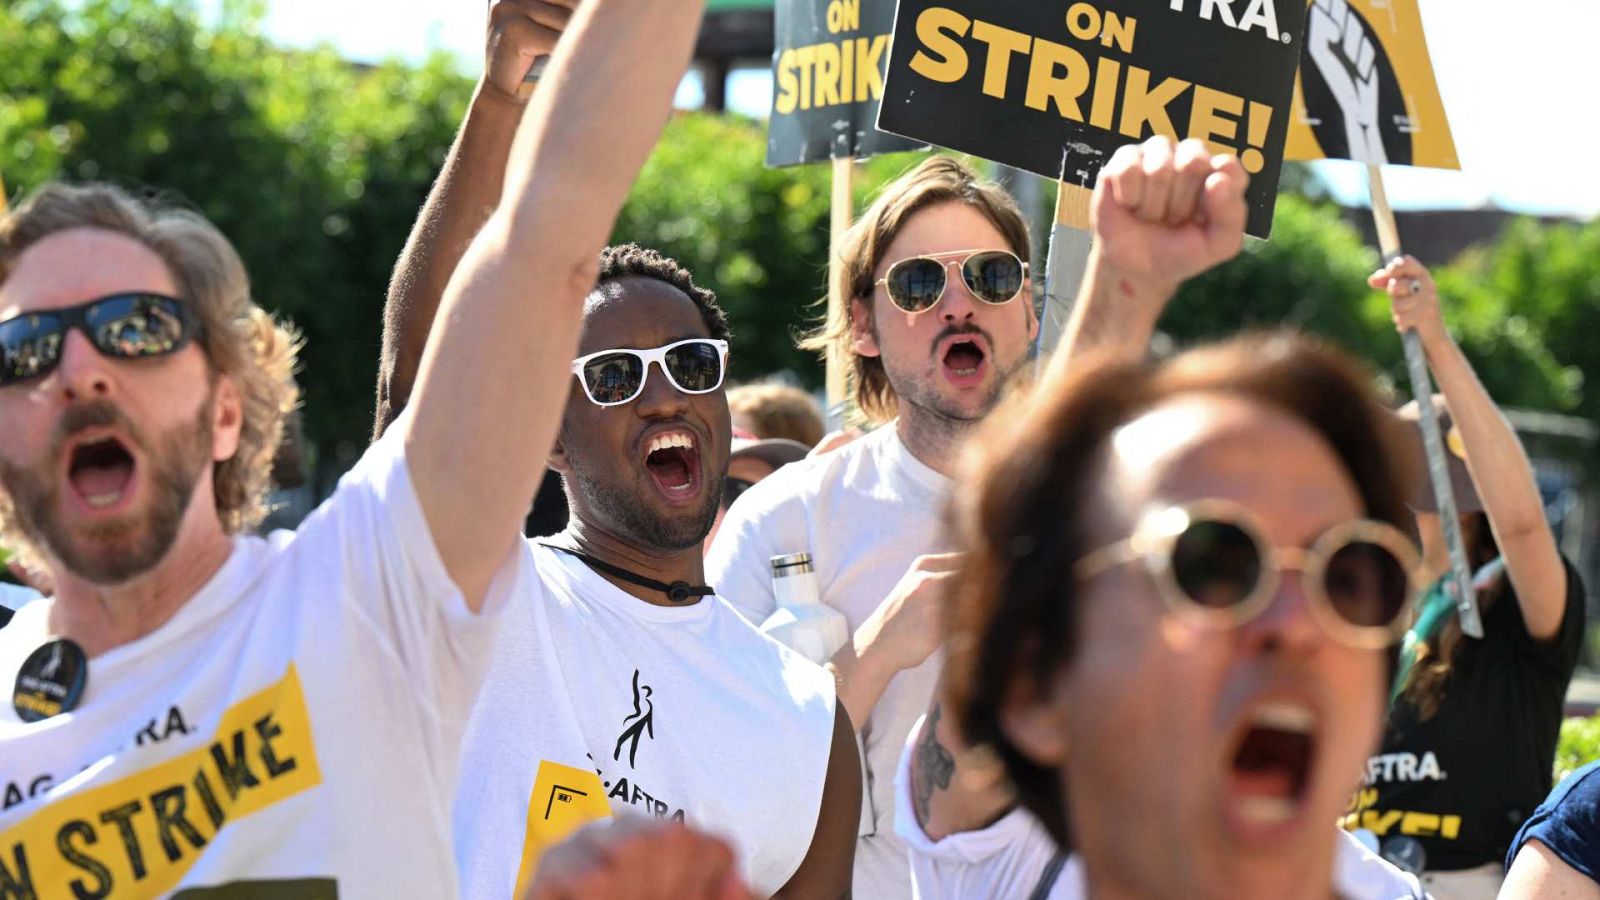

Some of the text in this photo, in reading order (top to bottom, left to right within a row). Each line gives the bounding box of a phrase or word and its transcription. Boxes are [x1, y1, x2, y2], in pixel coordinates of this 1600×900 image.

[826, 0, 860, 34] ON
[1066, 2, 1137, 54] ON
[775, 34, 892, 115] STRIK
[908, 7, 1273, 174] STRIKE!
[56, 711, 297, 900] STRIKE
